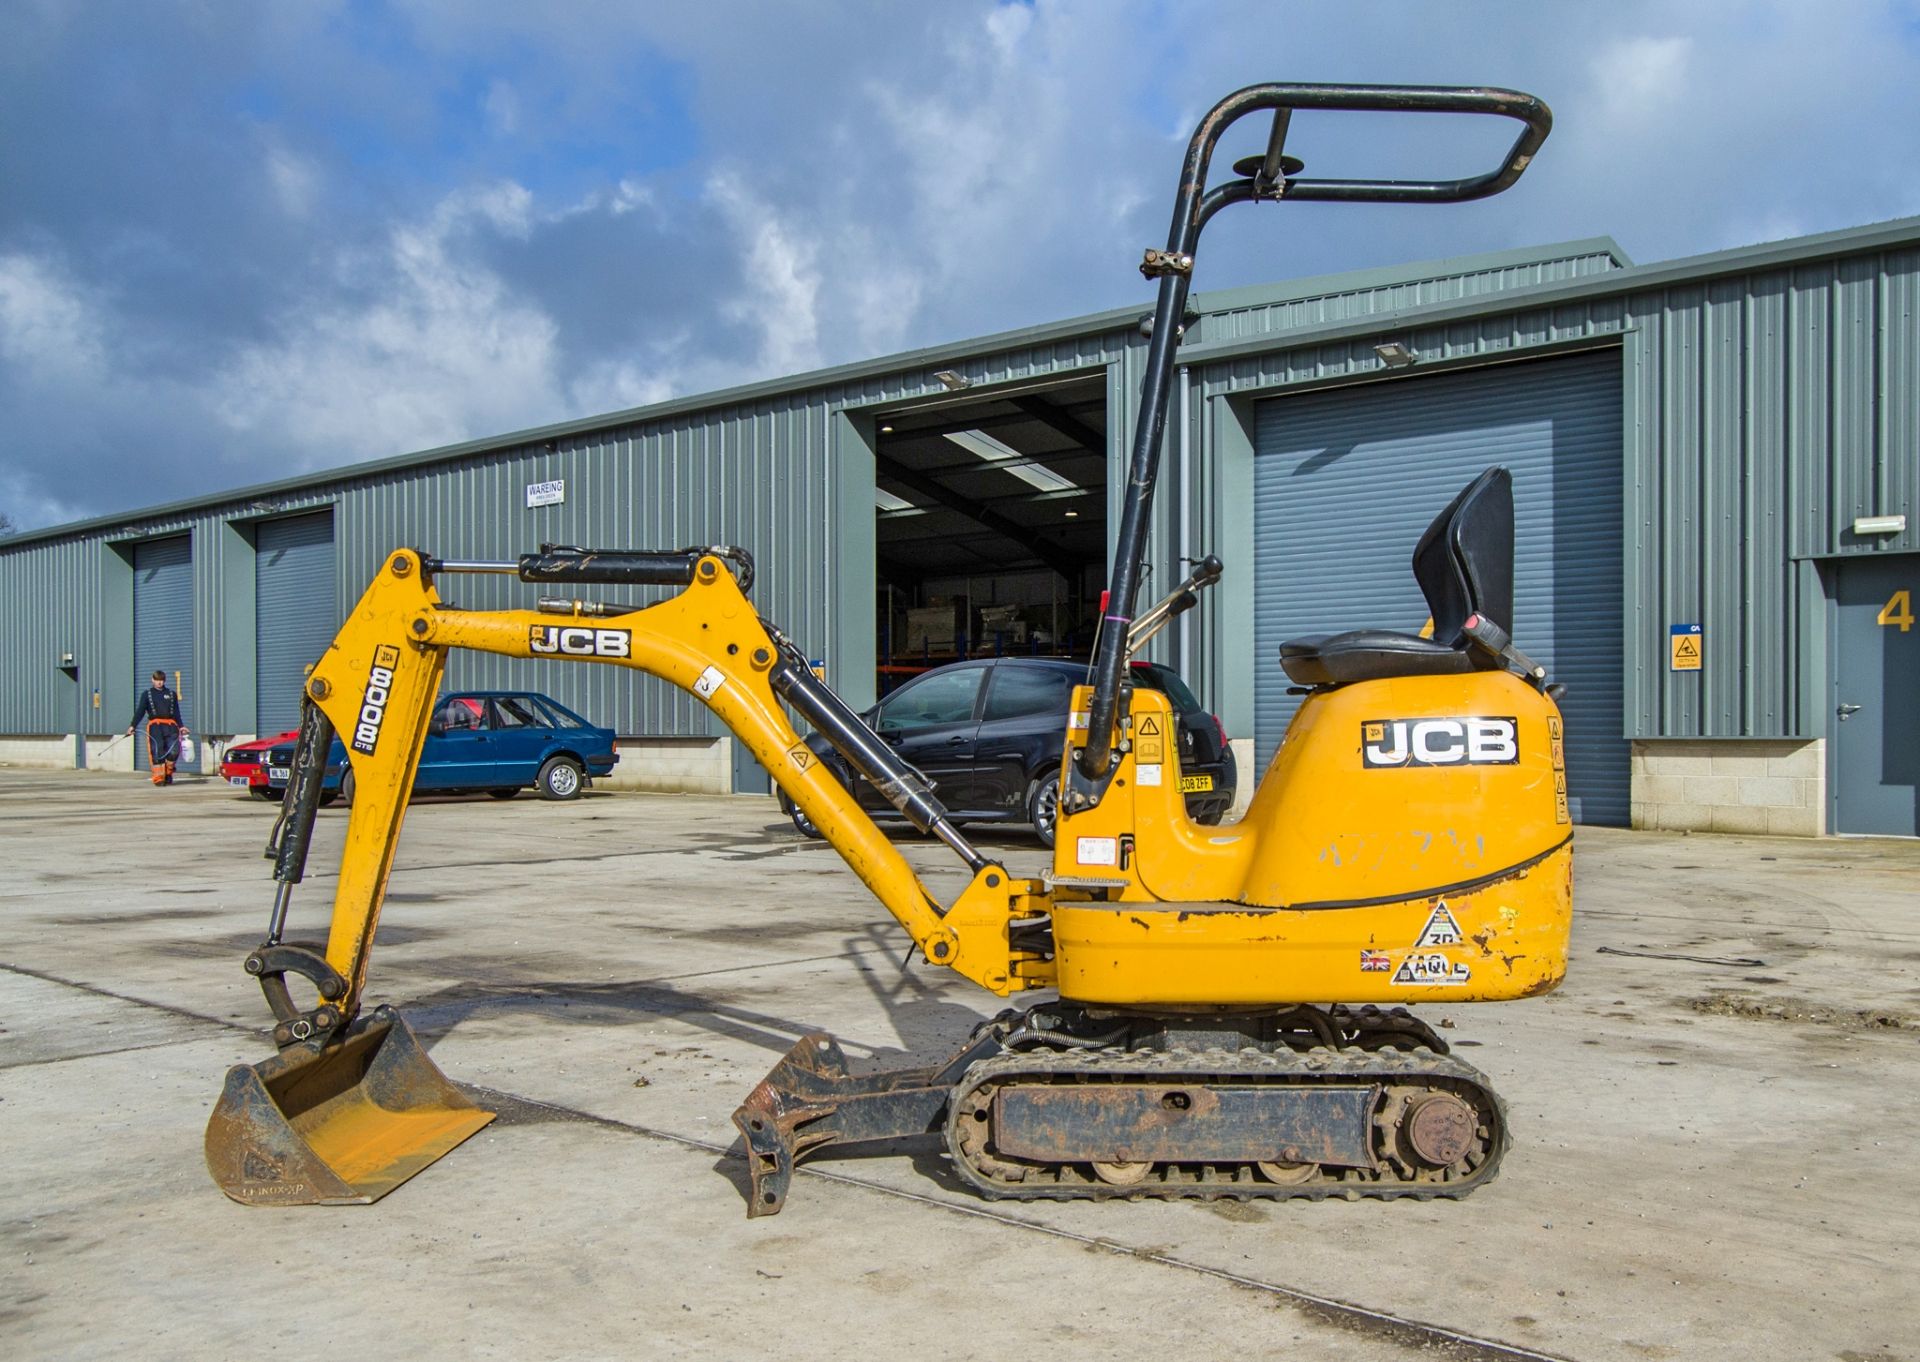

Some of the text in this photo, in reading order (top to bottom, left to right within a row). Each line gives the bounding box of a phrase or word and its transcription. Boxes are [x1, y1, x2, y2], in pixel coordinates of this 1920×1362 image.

[529, 481, 562, 495] WAREING
[1878, 591, 1914, 631] 4
[530, 627, 629, 656] JCB
[356, 667, 393, 744] 8008
[354, 741, 373, 751] CTS
[1366, 719, 1517, 764] JCB
[1195, 777, 1209, 789] ZFF
